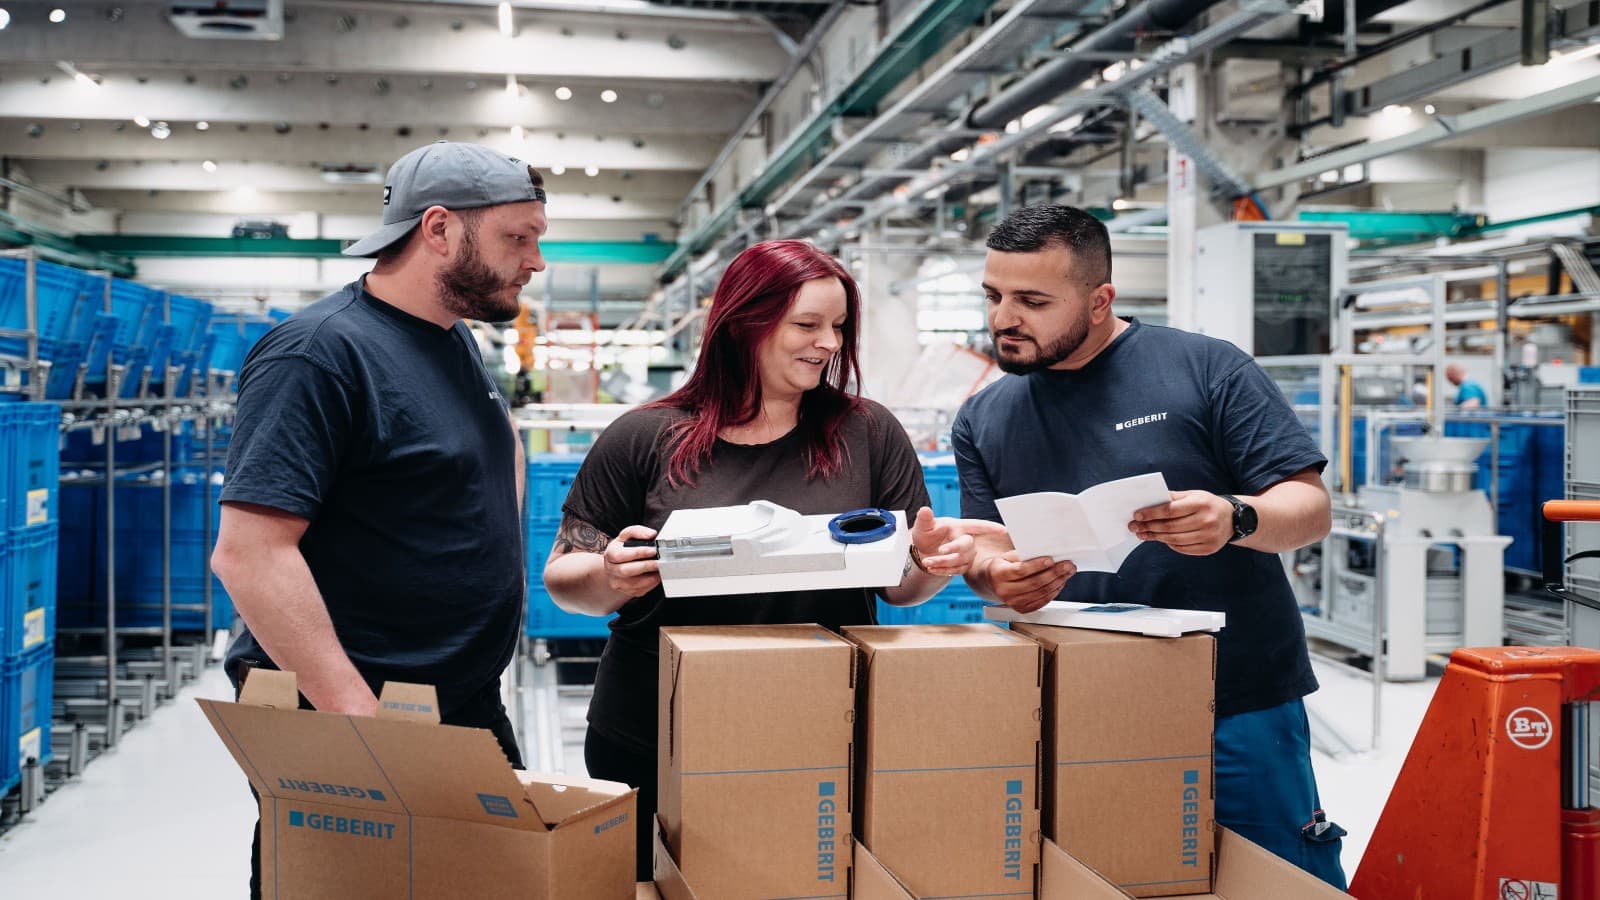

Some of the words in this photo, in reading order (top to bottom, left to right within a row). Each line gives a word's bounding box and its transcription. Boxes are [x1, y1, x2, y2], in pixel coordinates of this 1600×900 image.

[1124, 411, 1168, 428] GEBERIT
[1513, 717, 1547, 737] BT
[278, 778, 367, 798] GEBERIT
[307, 813, 395, 839] GEBERIT
[1004, 797, 1022, 881] GEBERIT
[1181, 786, 1199, 868] GEBERIT
[817, 799, 835, 882] GEBERIT
